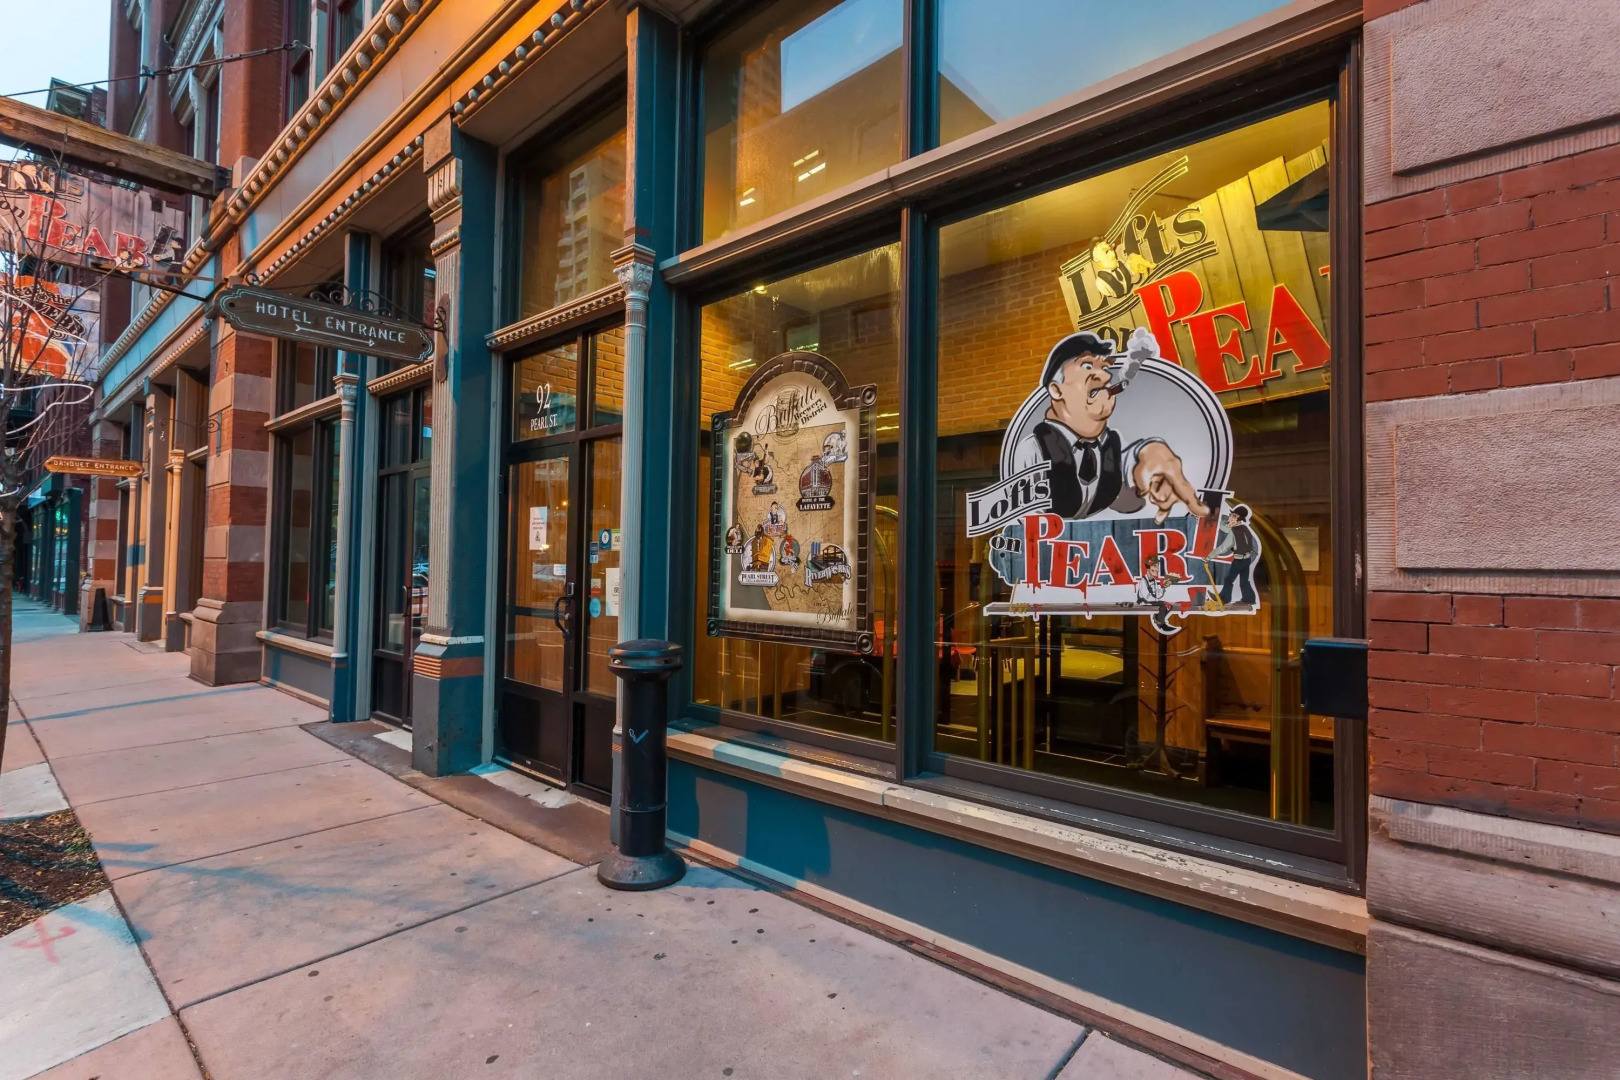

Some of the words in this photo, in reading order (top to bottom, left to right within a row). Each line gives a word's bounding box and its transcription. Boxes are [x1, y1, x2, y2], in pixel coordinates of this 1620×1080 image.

[255, 301, 312, 325] HOTEL
[325, 316, 406, 344] ENTRANCE
[1134, 265, 1330, 393] PEA
[536, 382, 552, 415] 92
[793, 398, 822, 421] Brewery
[530, 416, 548, 431] PEARL
[549, 413, 558, 428] ST.
[755, 385, 819, 441] Buffalo
[800, 402, 828, 425] District
[53, 460, 90, 468] BANQUET
[94, 463, 134, 471] ENTRANCE
[968, 478, 1051, 527] Lofts
[991, 533, 1022, 554] on
[1022, 490, 1235, 592] PEARL
[741, 574, 756, 582] PEARL
[756, 574, 774, 583] STREET
